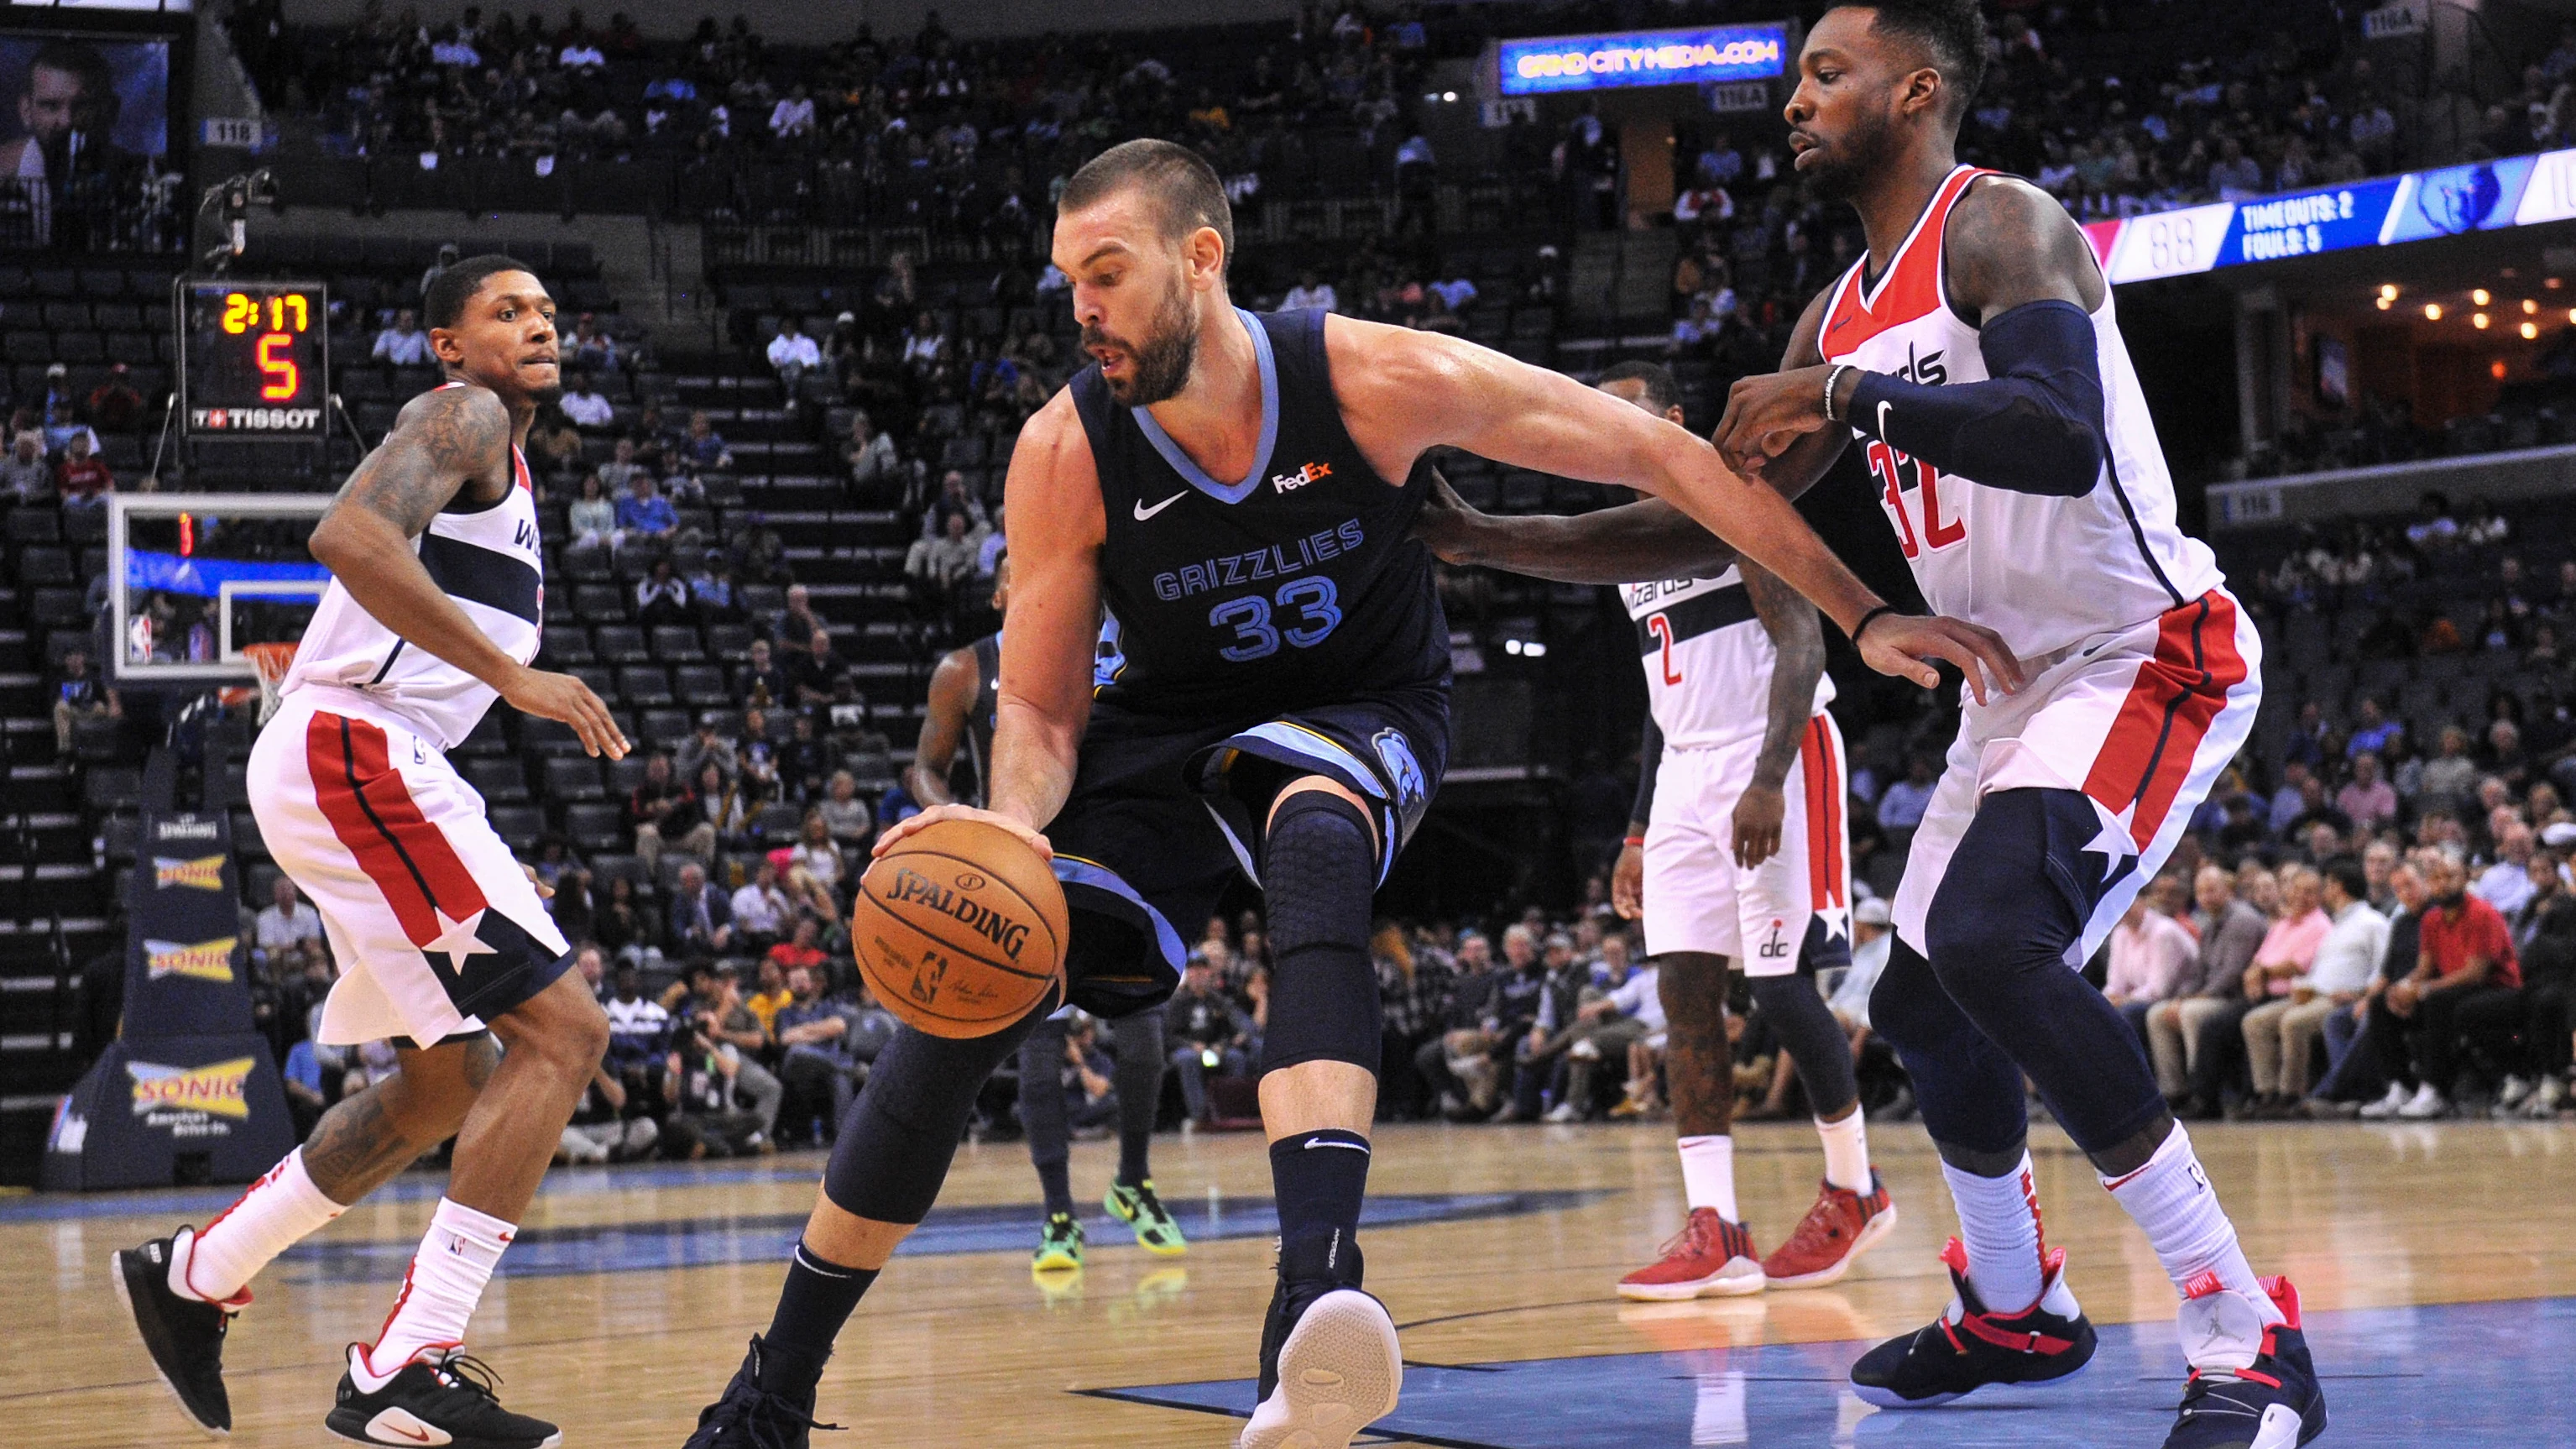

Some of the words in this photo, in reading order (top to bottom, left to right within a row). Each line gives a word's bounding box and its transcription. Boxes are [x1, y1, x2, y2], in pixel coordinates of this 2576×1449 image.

[2241, 194, 2338, 233] TIMEOUTS:
[2338, 190, 2354, 219] 2
[2242, 226, 2306, 261] FOULS:
[2306, 223, 2323, 253] 5
[223, 293, 307, 334] 2:17
[256, 332, 300, 401] 5
[227, 408, 321, 429] TISSOT
[1272, 462, 1333, 494] FedEx
[1153, 517, 1365, 601] GRIZZLIES
[1209, 575, 1342, 662] 33
[1647, 611, 1683, 687] 2
[886, 866, 1030, 960] SPALDING
[153, 949, 232, 969] SONIC
[139, 1072, 246, 1103] SONIC
